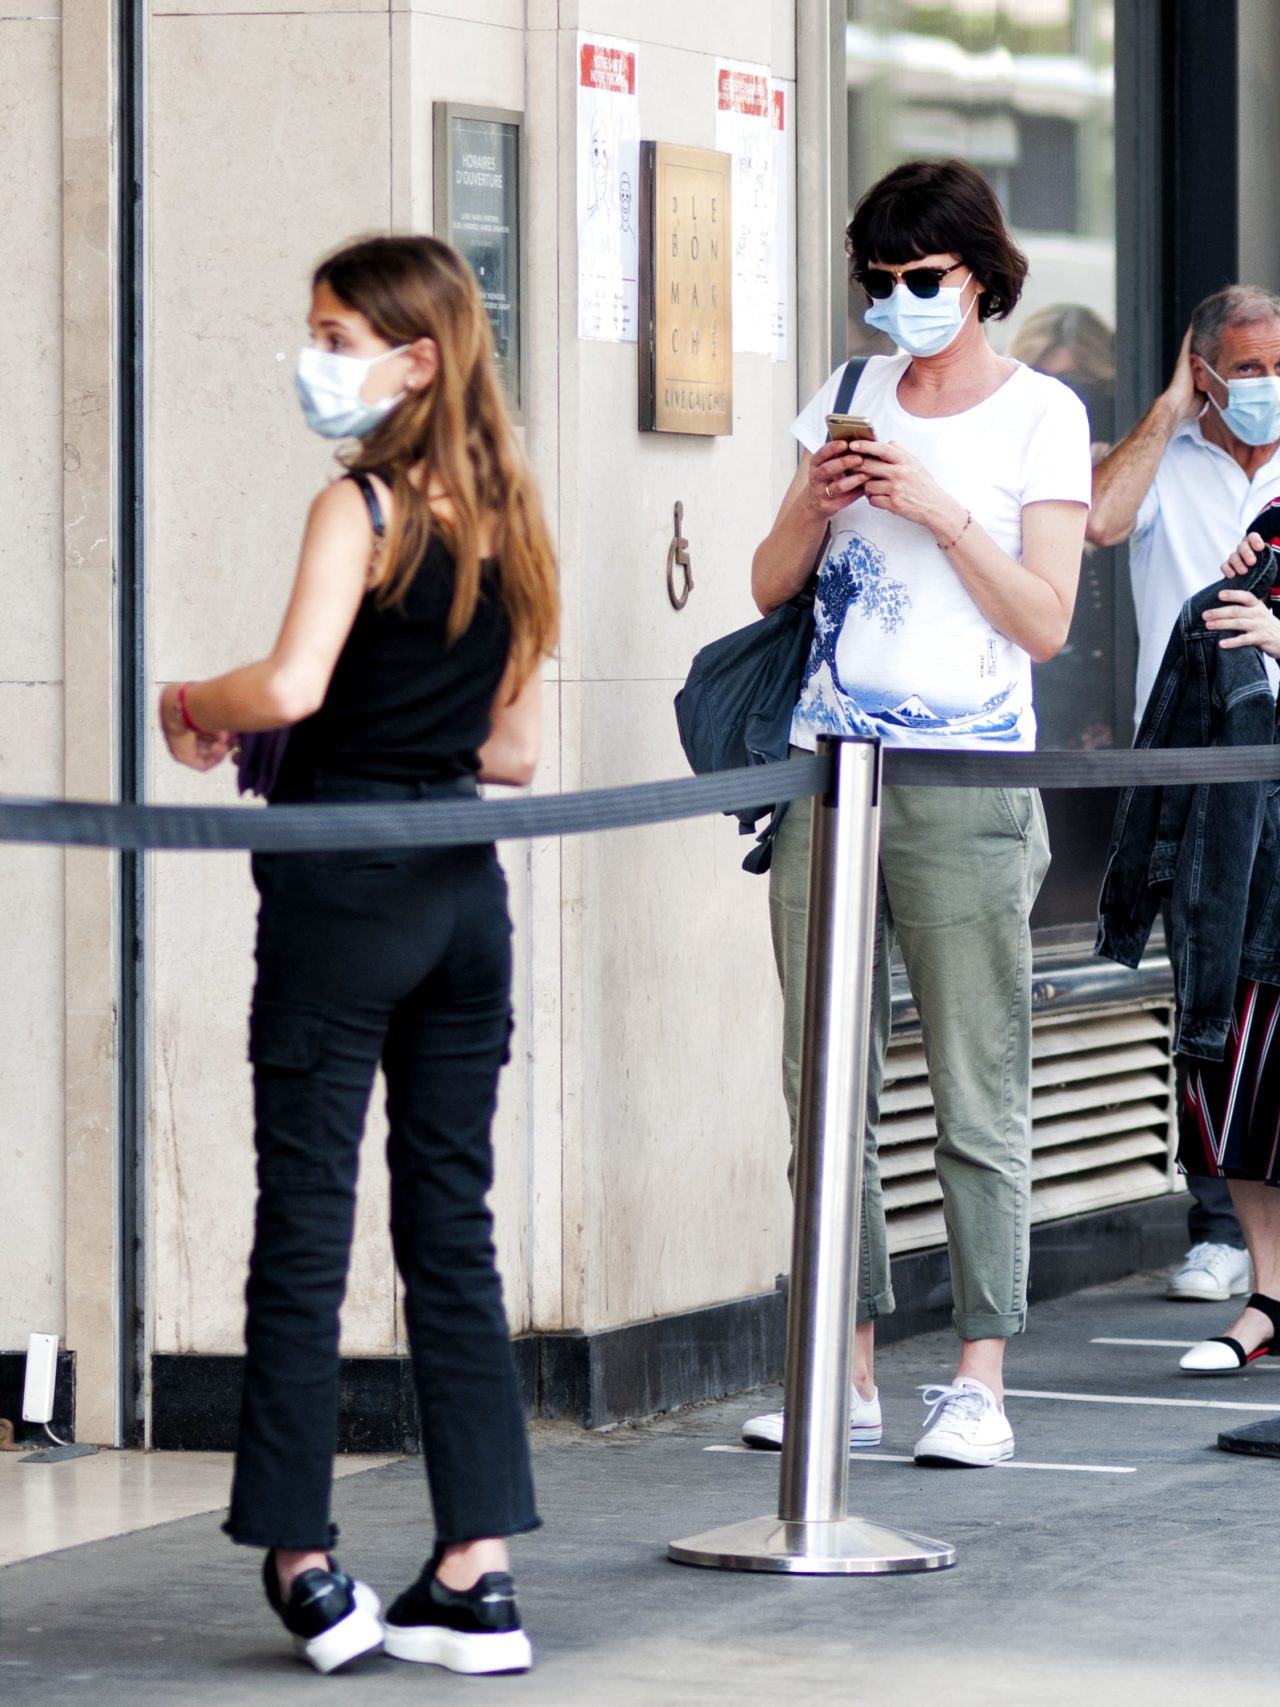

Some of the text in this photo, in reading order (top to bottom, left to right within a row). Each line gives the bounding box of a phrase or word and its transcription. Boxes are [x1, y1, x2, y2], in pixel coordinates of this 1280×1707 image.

[462, 154, 496, 171] HORAIRES
[456, 170, 503, 188] D'OUVERTURE
[671, 233, 718, 261] BON
